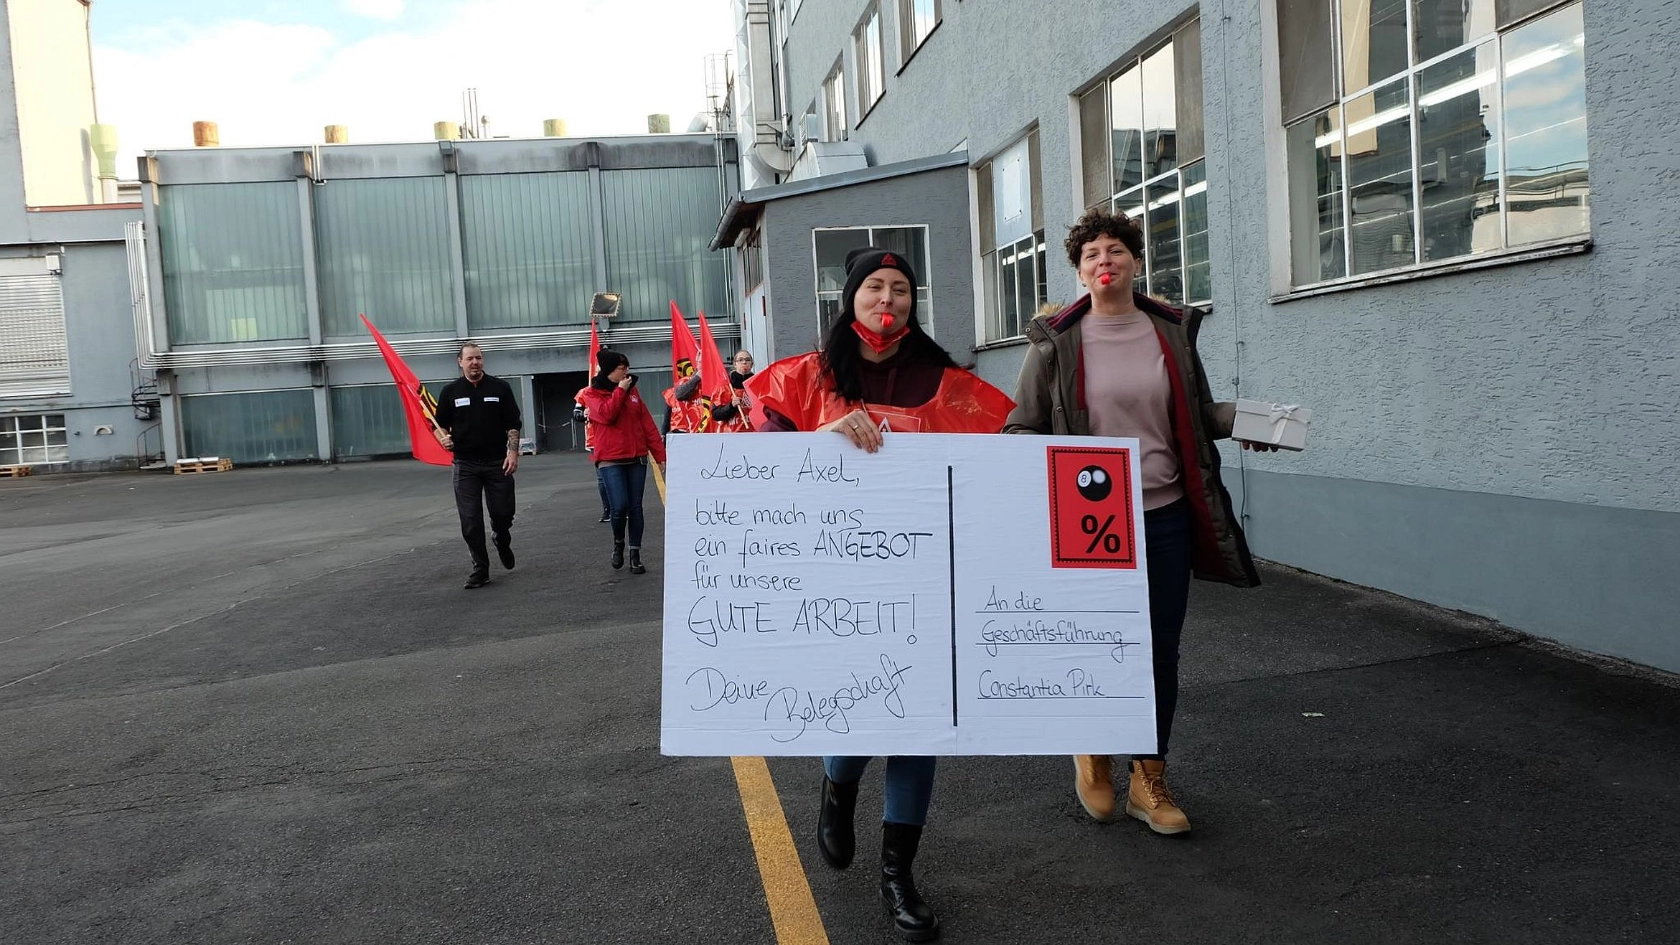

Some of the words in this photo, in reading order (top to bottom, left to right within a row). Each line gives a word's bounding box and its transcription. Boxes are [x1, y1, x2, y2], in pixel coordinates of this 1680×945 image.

[700, 442, 781, 480] Lieber
[797, 447, 860, 487] Axel,
[1080, 474, 1088, 484] 8
[695, 498, 744, 526] bitte
[752, 502, 807, 526] mach
[820, 508, 864, 533] uns
[1080, 514, 1121, 555] %
[694, 537, 727, 557] ein
[738, 529, 802, 568] faires
[813, 528, 933, 563] ANGEBOT
[691, 560, 720, 589] für
[729, 572, 803, 592] unsere
[984, 584, 1009, 611] An
[1013, 590, 1045, 612] die
[687, 595, 777, 648] GUTE
[792, 593, 918, 645] ARBEIT!
[981, 619, 1130, 664] Geschäftsführung
[685, 666, 770, 712] Deine
[764, 653, 913, 743] Belegschaft
[978, 669, 1066, 699] Constantia
[1066, 667, 1106, 698] Pirk
